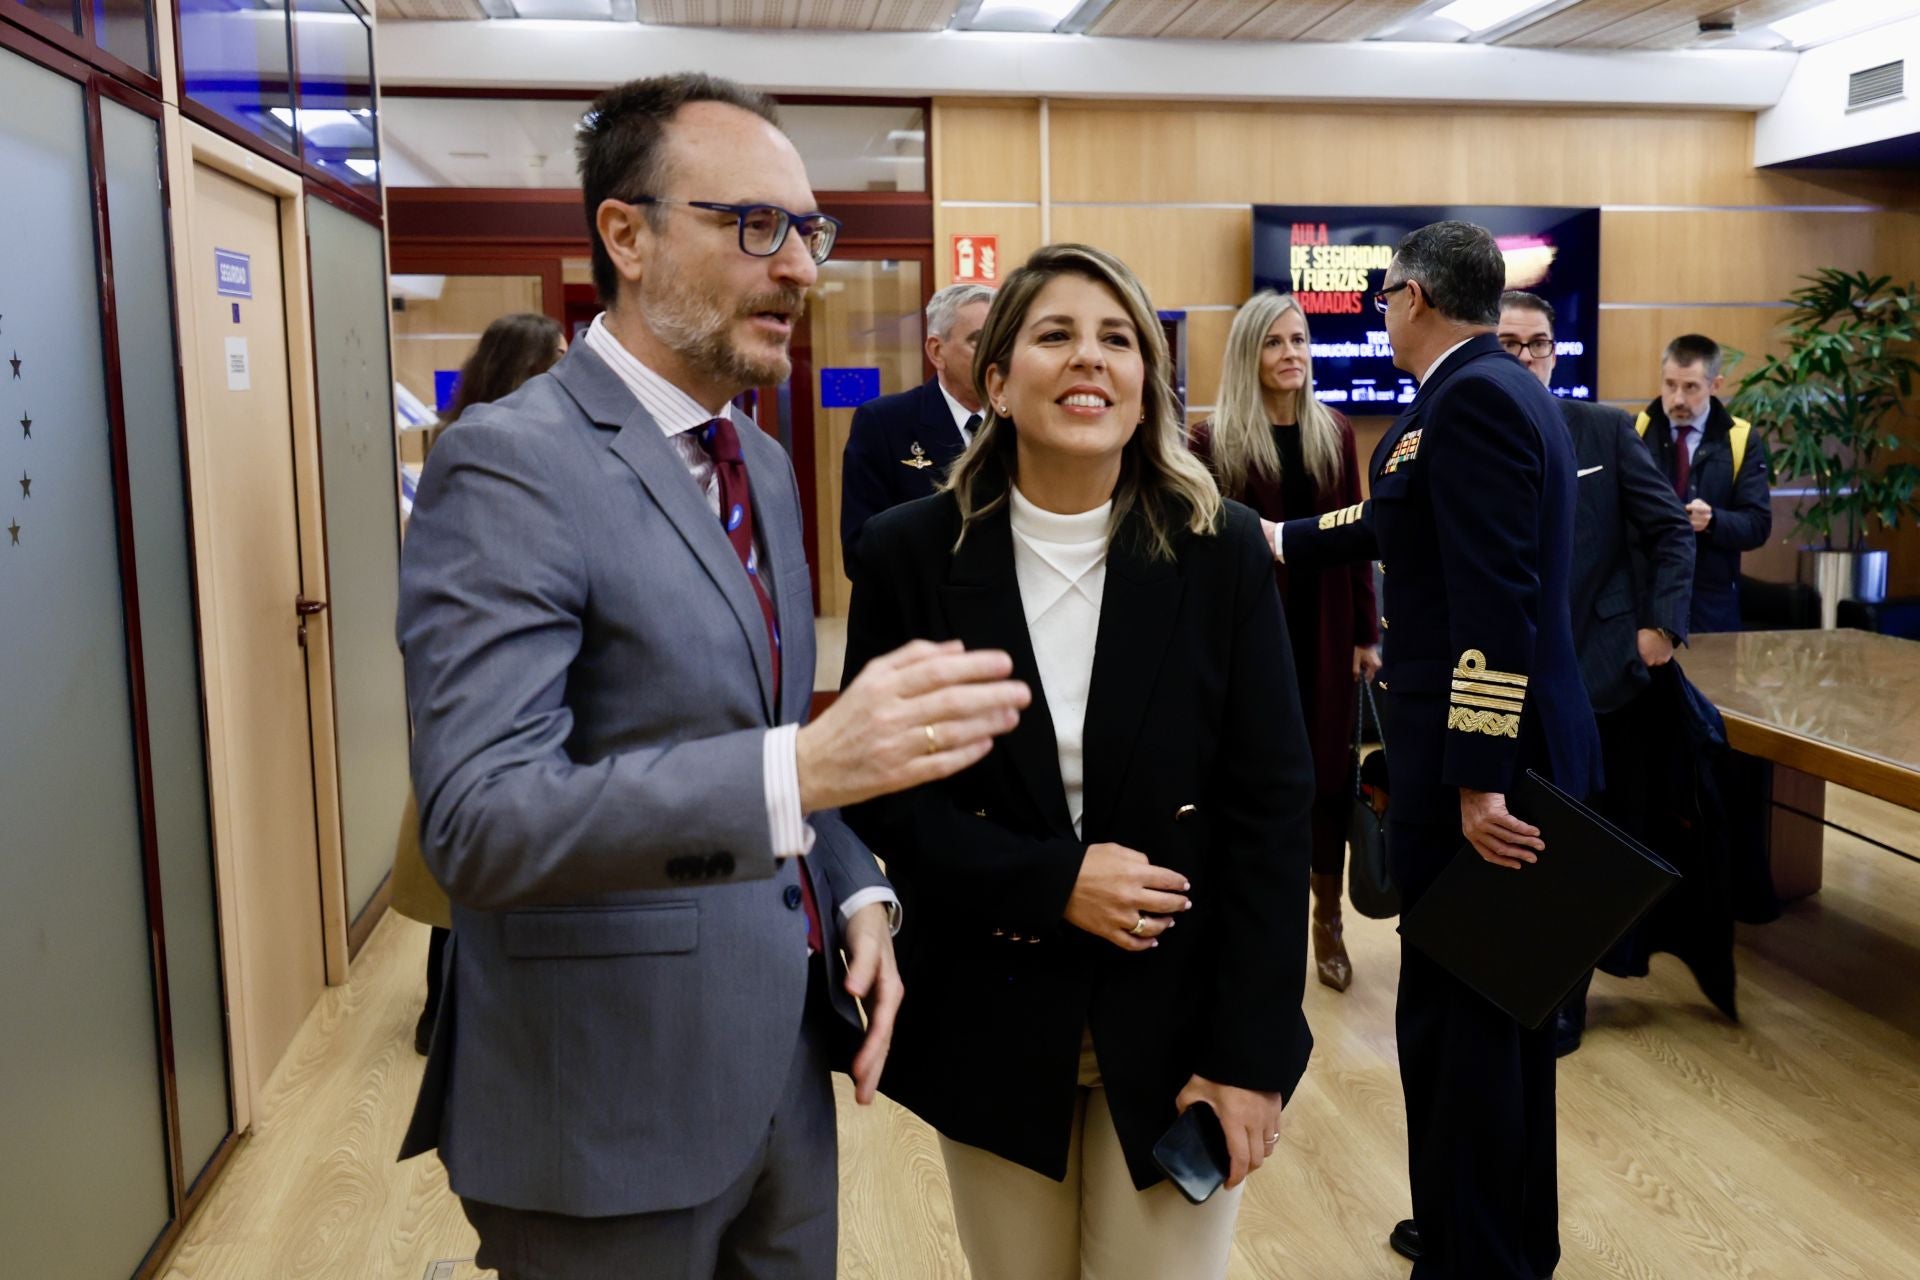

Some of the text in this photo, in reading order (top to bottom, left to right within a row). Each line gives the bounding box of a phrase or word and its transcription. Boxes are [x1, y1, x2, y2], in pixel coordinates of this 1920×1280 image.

[1291, 223, 1328, 245] AULA
[1290, 246, 1393, 269] DE SEGURIDAD
[220, 263, 247, 284] SEGURIDAD
[1290, 269, 1369, 292] Y FUERZAS
[1360, 343, 1375, 357] DE
